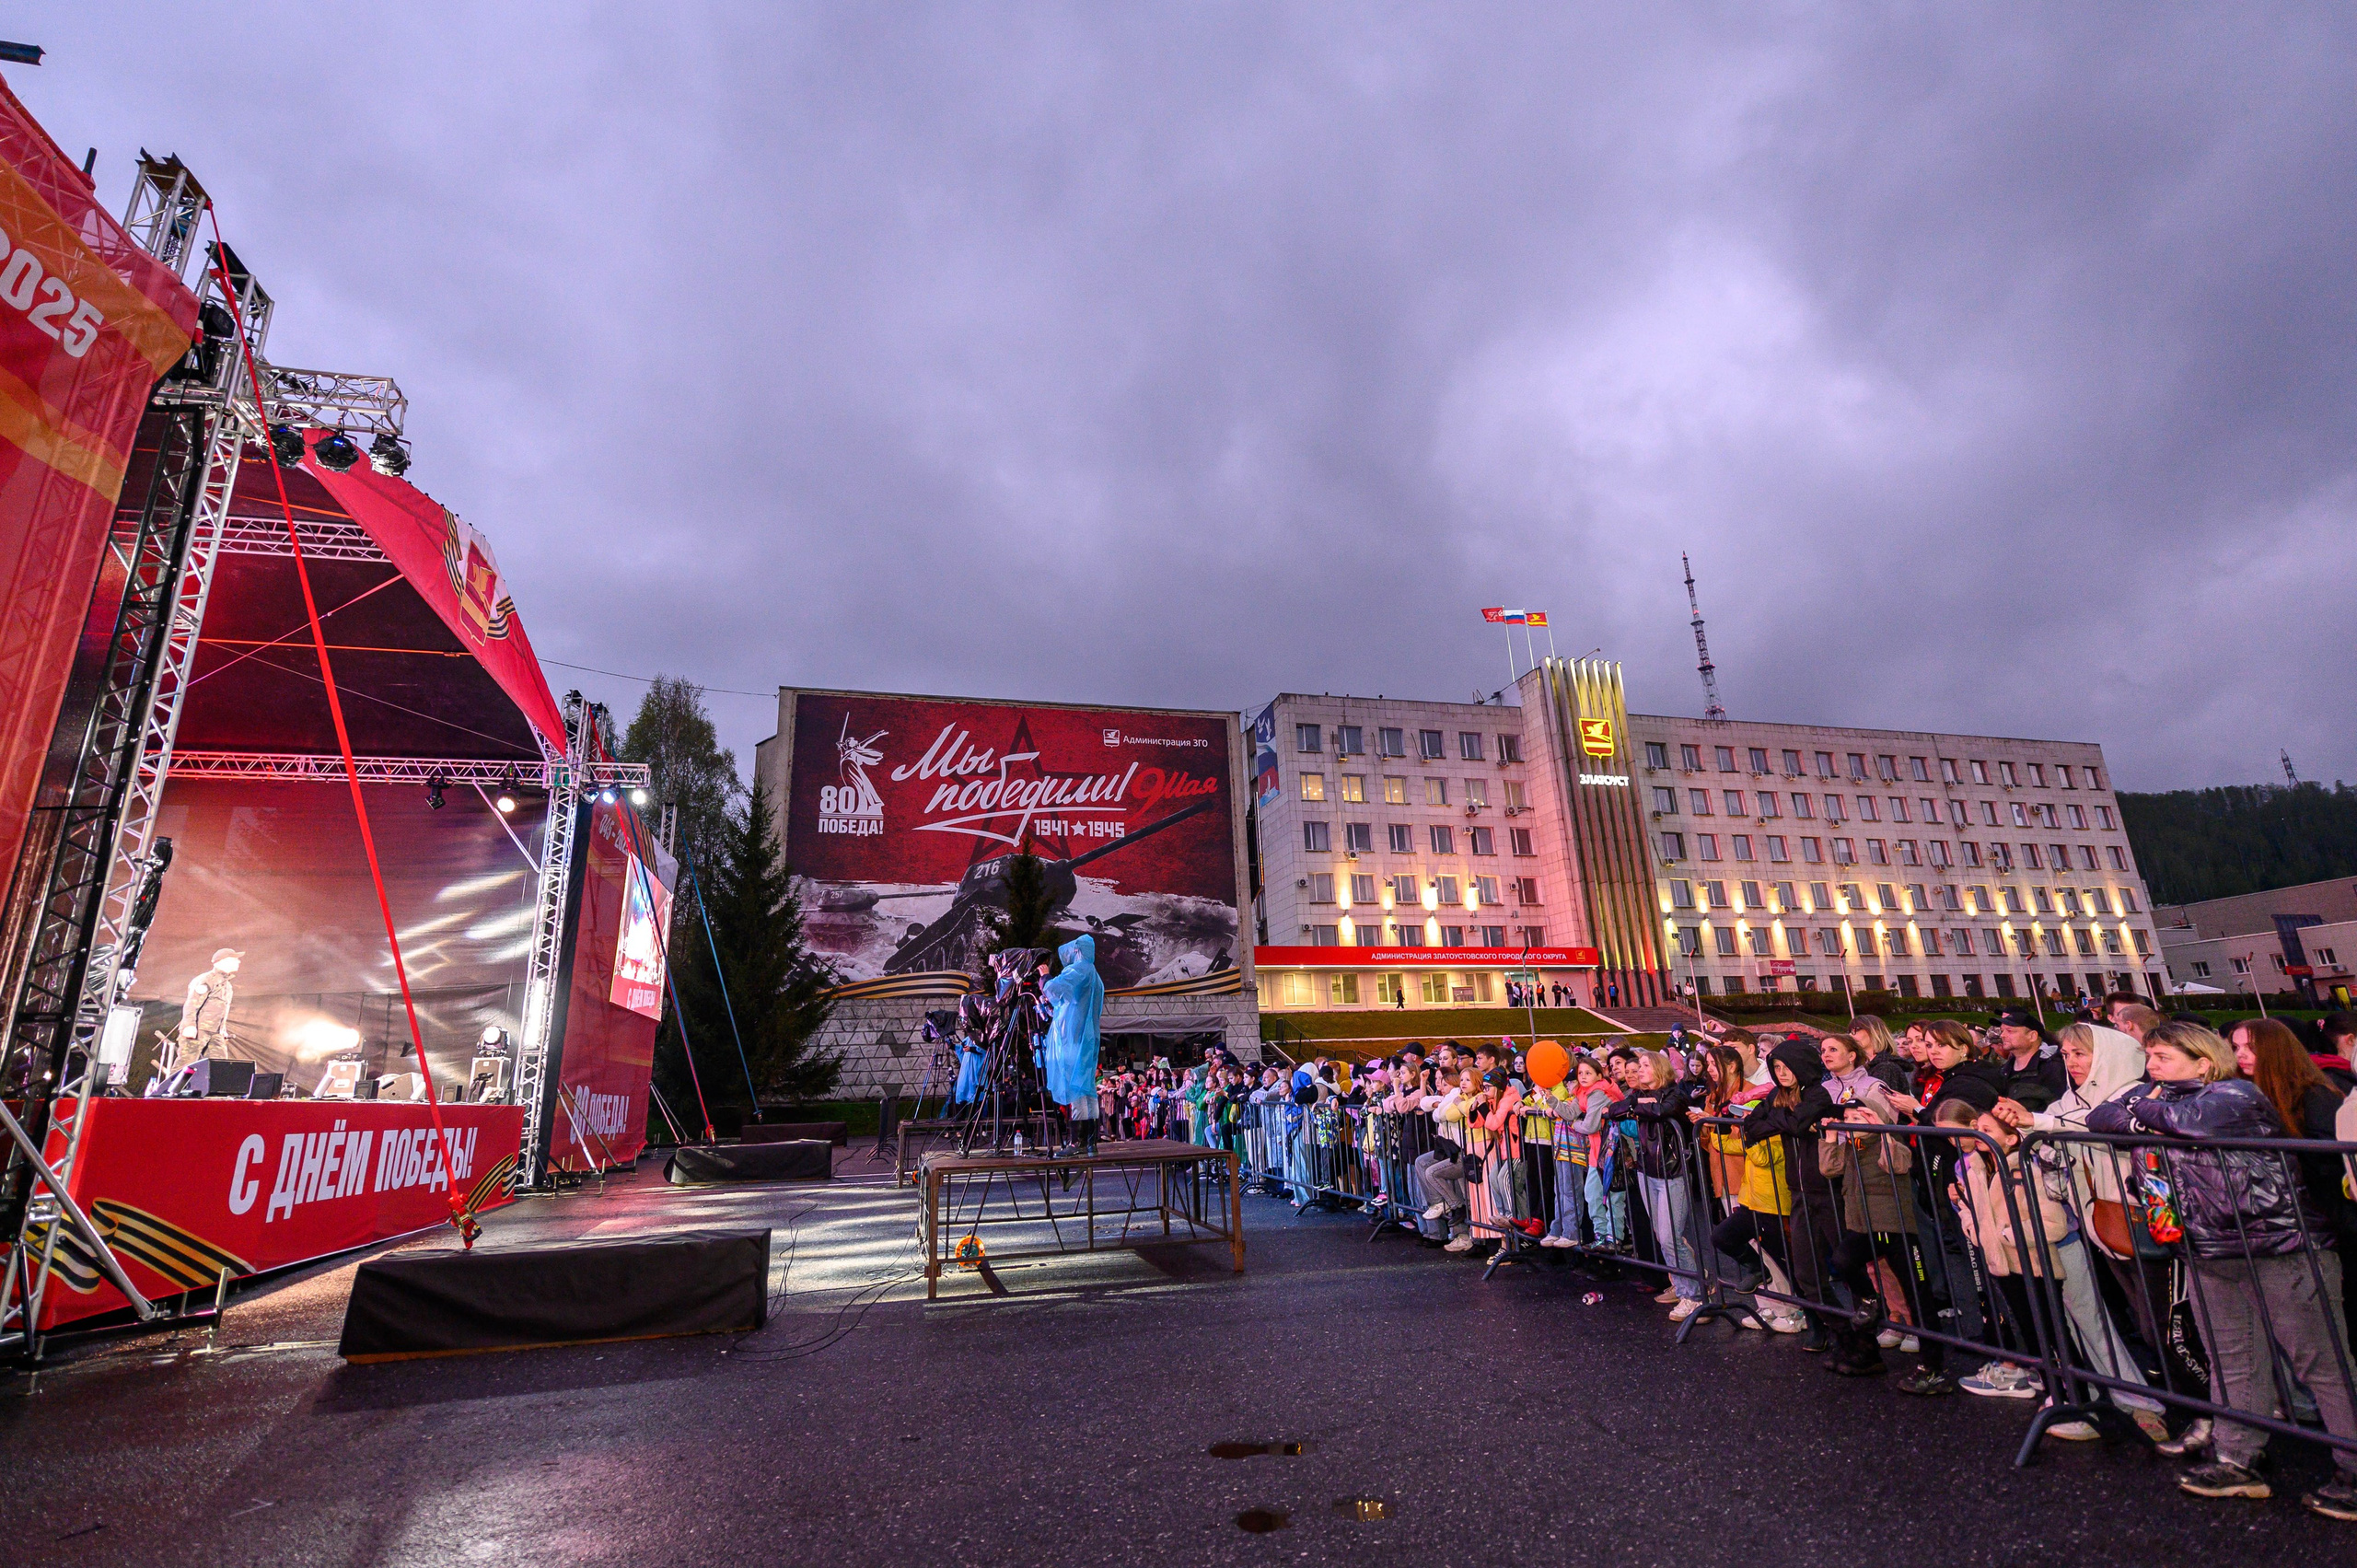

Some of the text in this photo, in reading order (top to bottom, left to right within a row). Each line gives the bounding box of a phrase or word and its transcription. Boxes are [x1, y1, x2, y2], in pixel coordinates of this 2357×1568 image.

[1122, 735, 1209, 748] Администрация ЗГО
[890, 721, 994, 782] Мы
[923, 752, 1140, 815] победили!
[1579, 774, 1630, 786] ЗЛАТОУСТ
[819, 784, 856, 814] 80
[1123, 767, 1218, 826] 9 Мая
[818, 818, 884, 837] ПОБЕДА!
[1034, 819, 1125, 838] 1941 1945
[973, 860, 1001, 879] 216
[830, 890, 844, 900] 257
[1371, 952, 1433, 960] АДМИНИСТРАЦИЯ
[1433, 952, 1497, 960] ЗЛАТОУСТОВСКОГО
[586, 1093, 629, 1141] ПОБЕДА!
[228, 1119, 479, 1224] С ДНЁМ ПОБЕДЫ!
